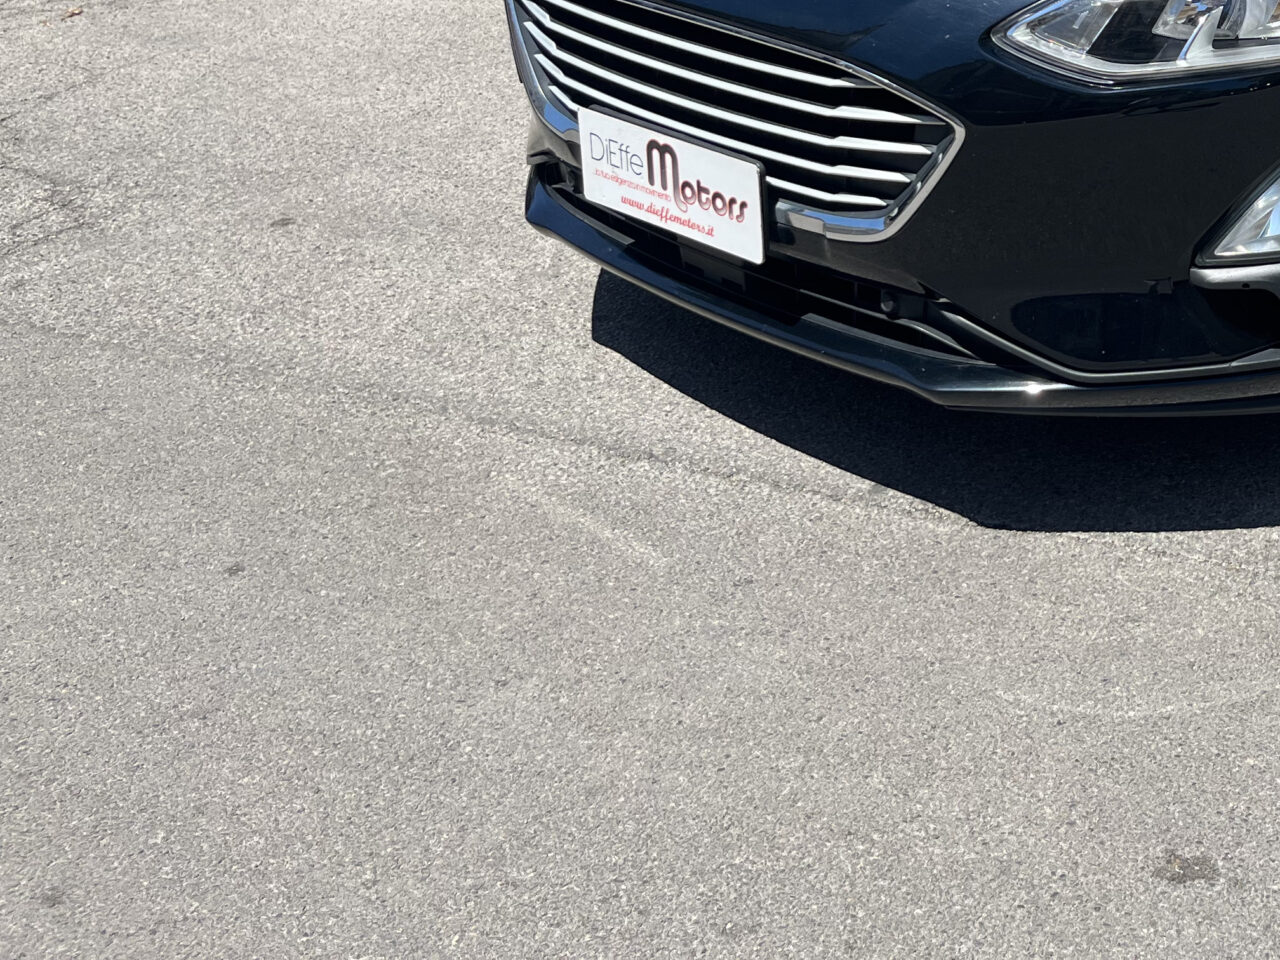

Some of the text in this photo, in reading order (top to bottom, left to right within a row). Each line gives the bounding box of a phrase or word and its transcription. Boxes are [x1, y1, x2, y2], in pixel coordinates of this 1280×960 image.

[590, 132, 748, 223] DiEffe Motors
[621, 195, 715, 238] www.dieffemotors.it
